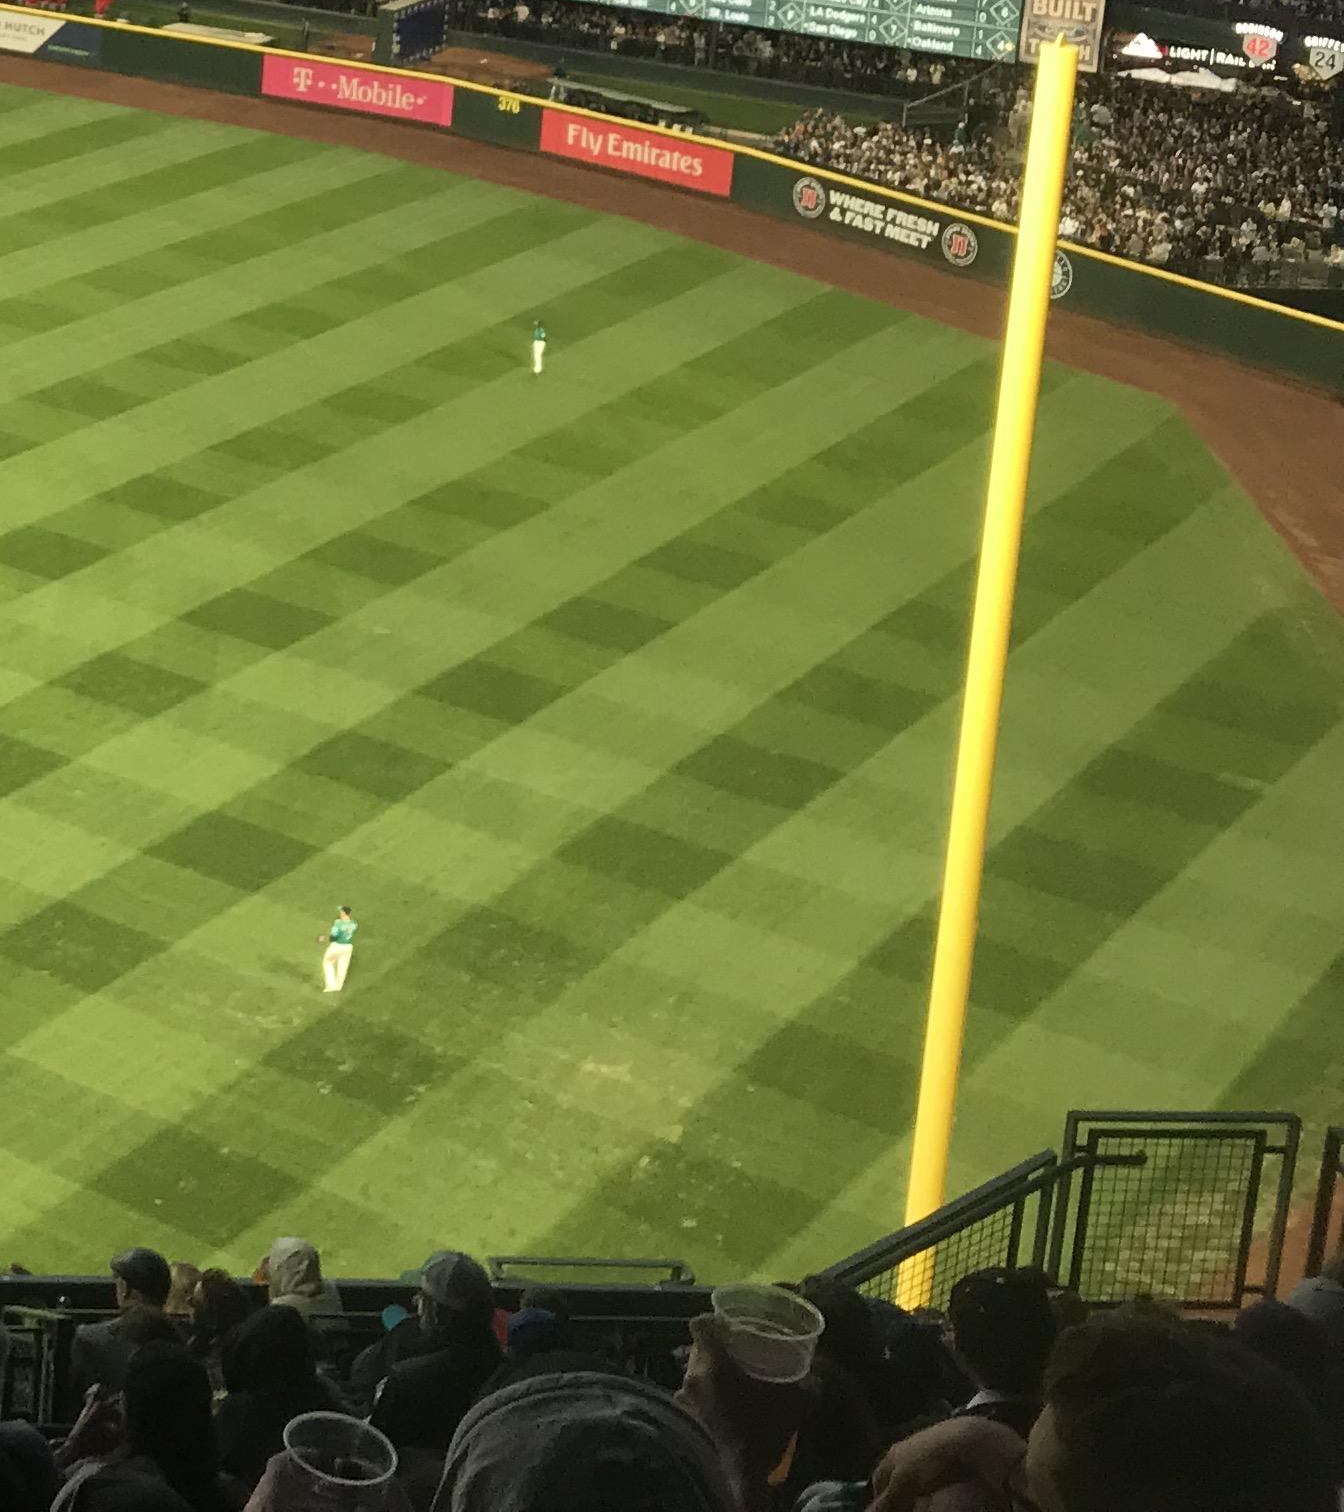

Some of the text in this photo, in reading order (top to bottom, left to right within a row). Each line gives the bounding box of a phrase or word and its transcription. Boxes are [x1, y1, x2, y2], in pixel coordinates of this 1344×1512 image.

[4, 21, 46, 36] HUTCH
[1246, 39, 1270, 57] 42
[1314, 51, 1336, 71] 24
[567, 124, 703, 177] Fly Emirates
[829, 190, 940, 238] WHERE FRESH
[844, 209, 886, 235] FAST
[884, 223, 934, 250] MEET
